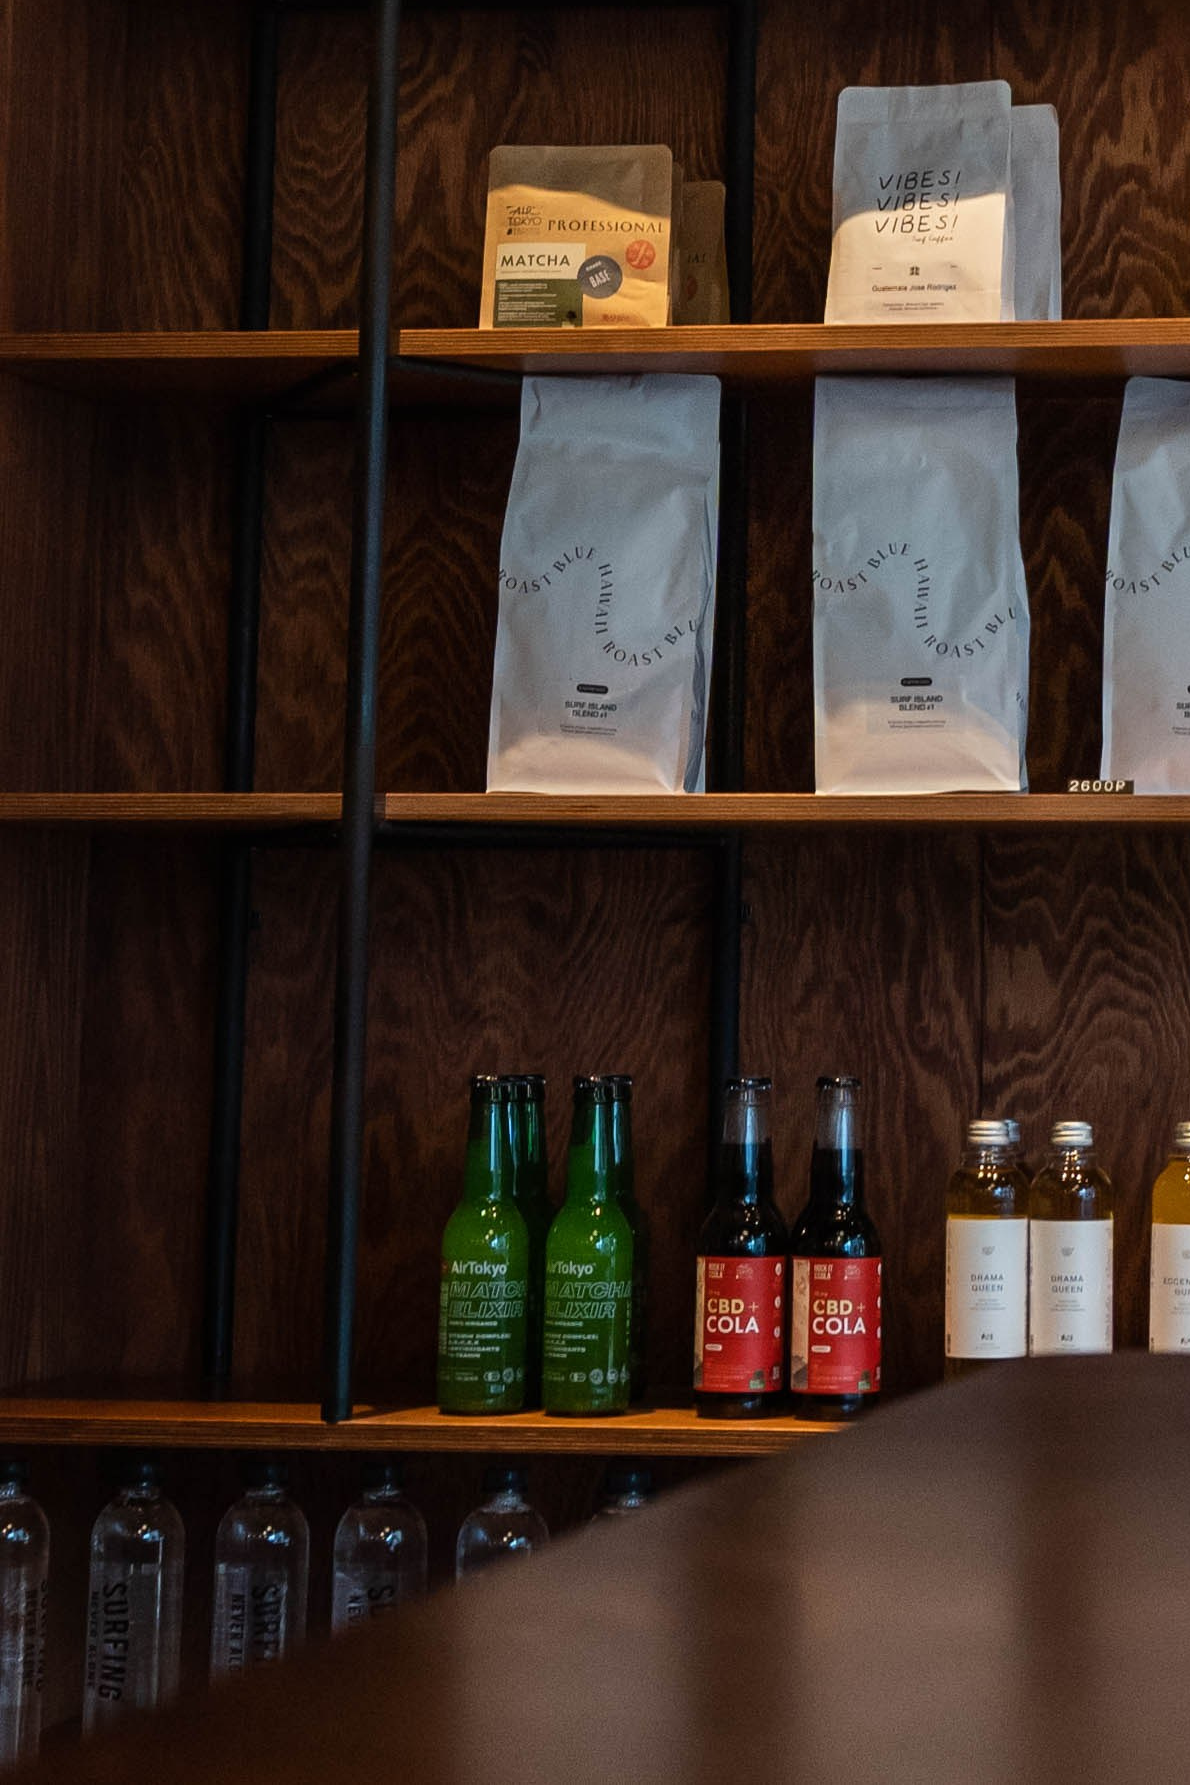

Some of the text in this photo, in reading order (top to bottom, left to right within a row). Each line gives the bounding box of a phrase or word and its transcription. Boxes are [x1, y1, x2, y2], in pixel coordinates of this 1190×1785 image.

[878, 170, 961, 190] VIBES!
[876, 192, 960, 212] VIBES!
[547, 219, 665, 234] PROFESSIONAL
[875, 214, 959, 234] VIBES!
[501, 253, 570, 268] MATCHA
[553, 546, 596, 573] BLUE
[602, 641, 664, 667] ROAST
[867, 542, 911, 570] BLUE
[924, 634, 985, 659] ROAST
[451, 1261, 508, 1278] AirTokyo
[970, 1274, 1004, 1282] DRAMA
[1050, 1275, 1084, 1283] DRAMA
[971, 1284, 1004, 1292] QUEEN
[1051, 1285, 1084, 1293] QUEEN
[707, 1298, 745, 1314] CBD
[813, 1299, 852, 1315] CBD
[706, 1316, 760, 1334] COLA
[812, 1317, 866, 1335] COLA
[99, 1583, 129, 1700] SURFING
